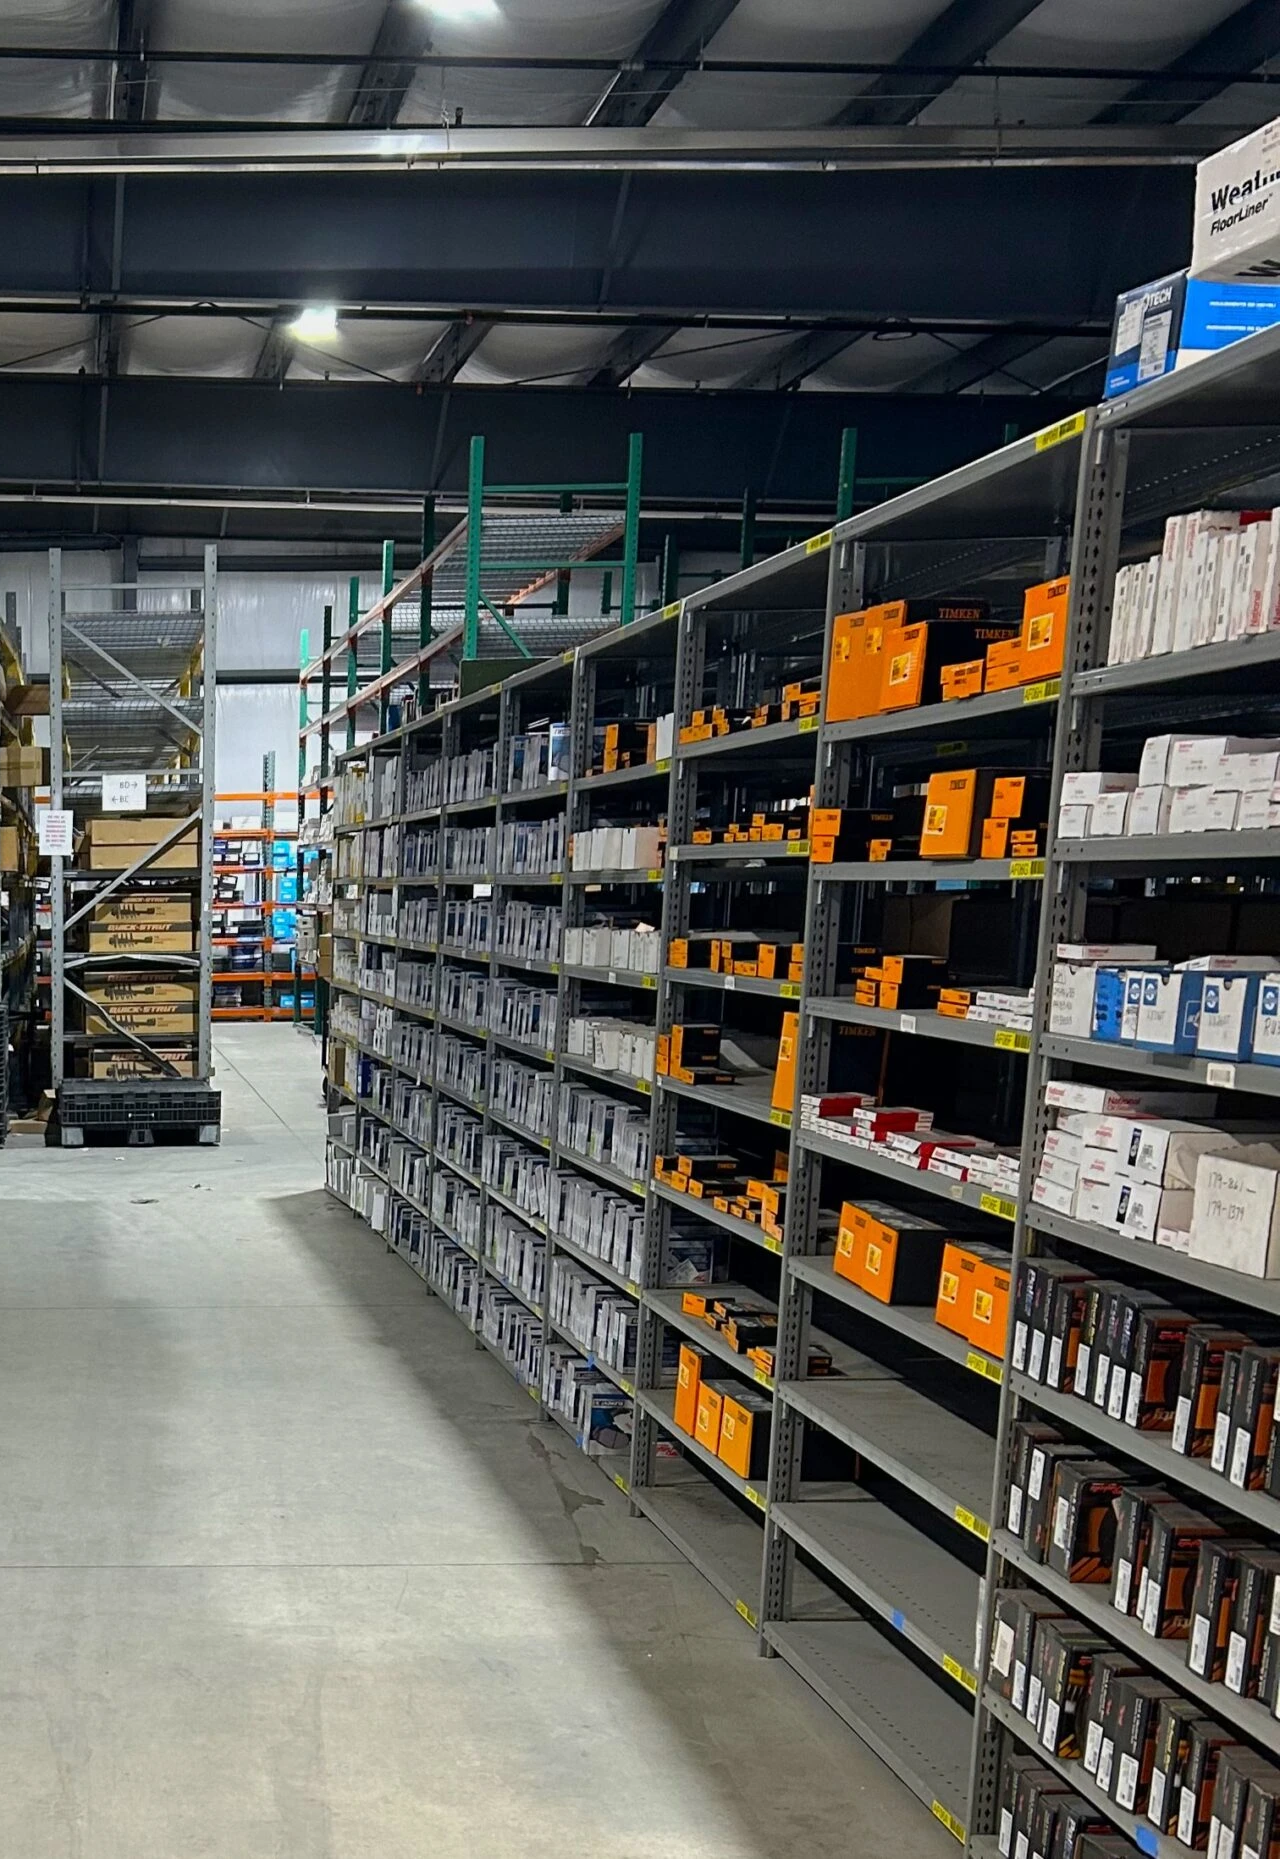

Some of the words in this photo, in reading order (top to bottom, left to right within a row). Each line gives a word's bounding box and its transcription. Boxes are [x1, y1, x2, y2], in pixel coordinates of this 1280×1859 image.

[1211, 169, 1280, 213] Weat
[1209, 198, 1269, 237] FloorLiner
[939, 607, 982, 620] TIMKEN
